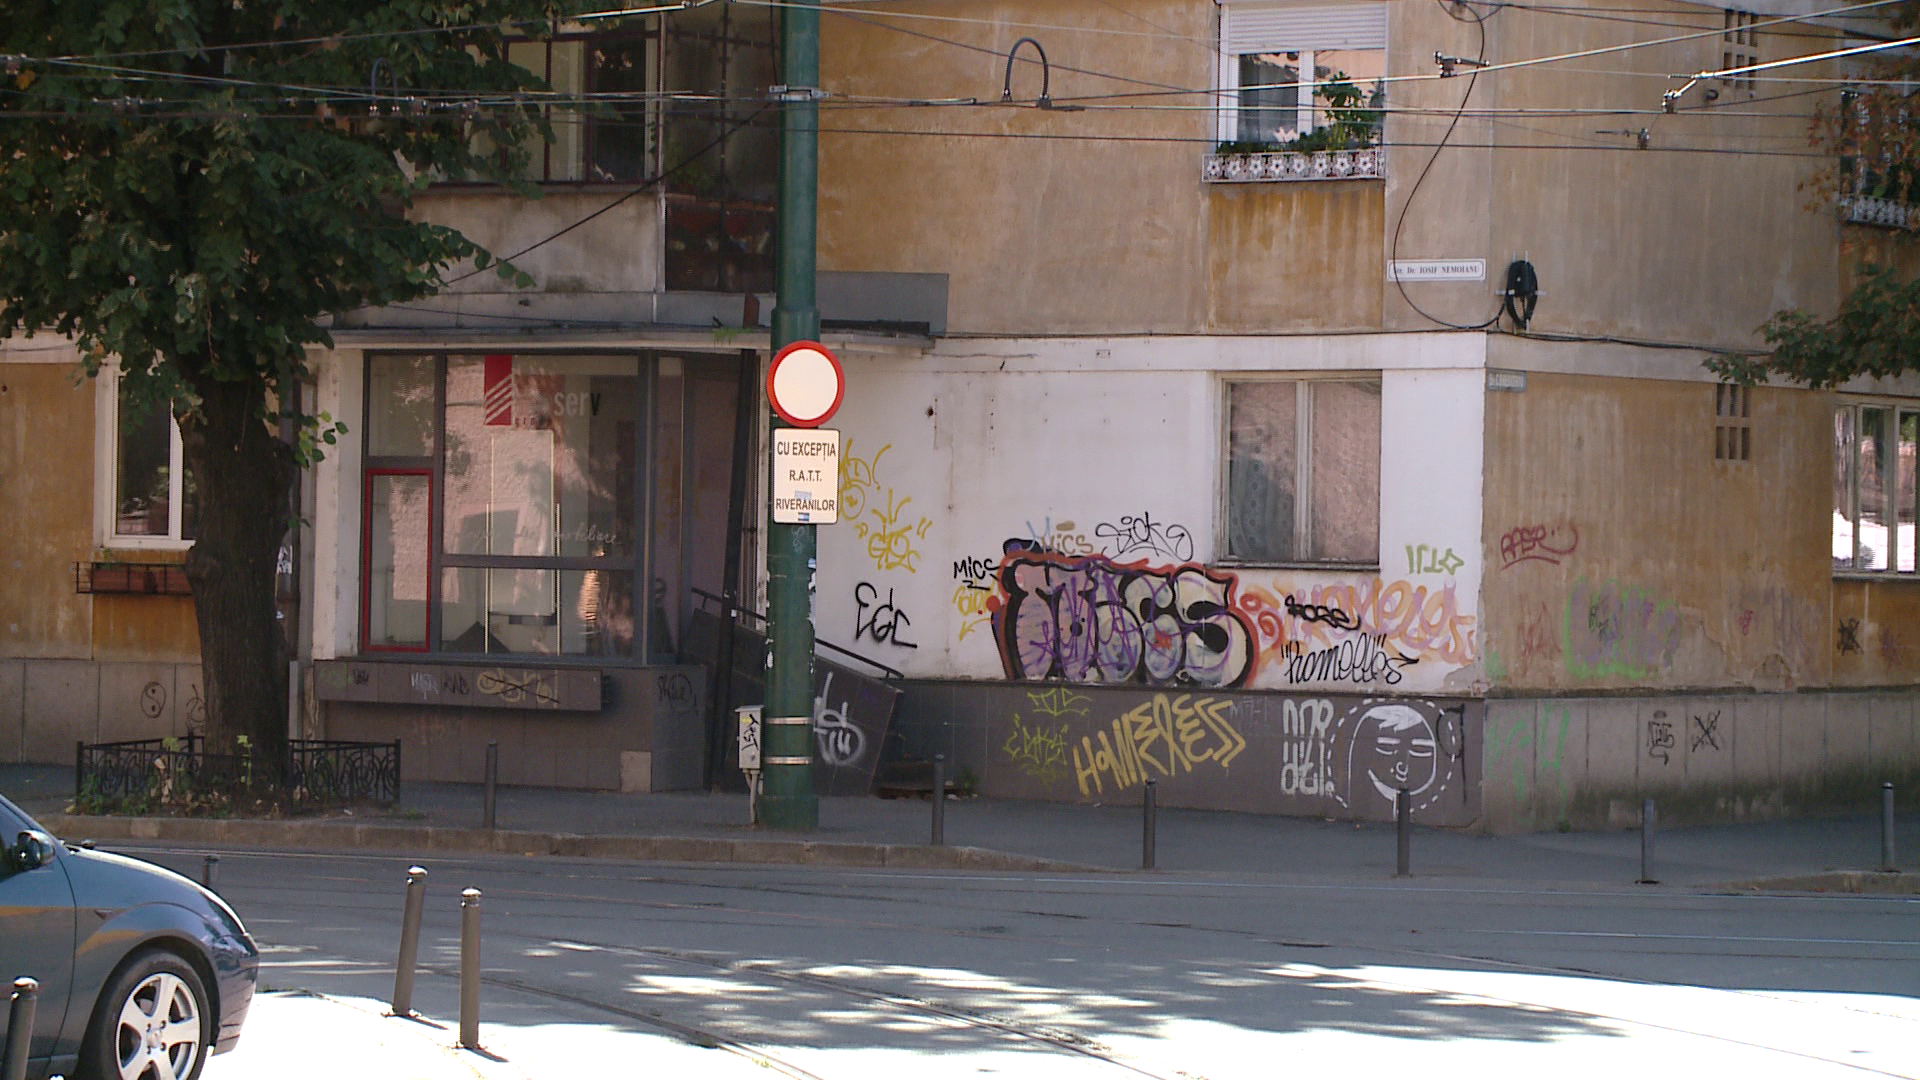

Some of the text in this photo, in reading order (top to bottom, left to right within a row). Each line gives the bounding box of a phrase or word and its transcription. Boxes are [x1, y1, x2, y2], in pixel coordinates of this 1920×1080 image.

[777, 441, 790, 456] CU
[789, 469, 823, 482] R.A.T.T.
[775, 498, 836, 512] RIVERANILOR
